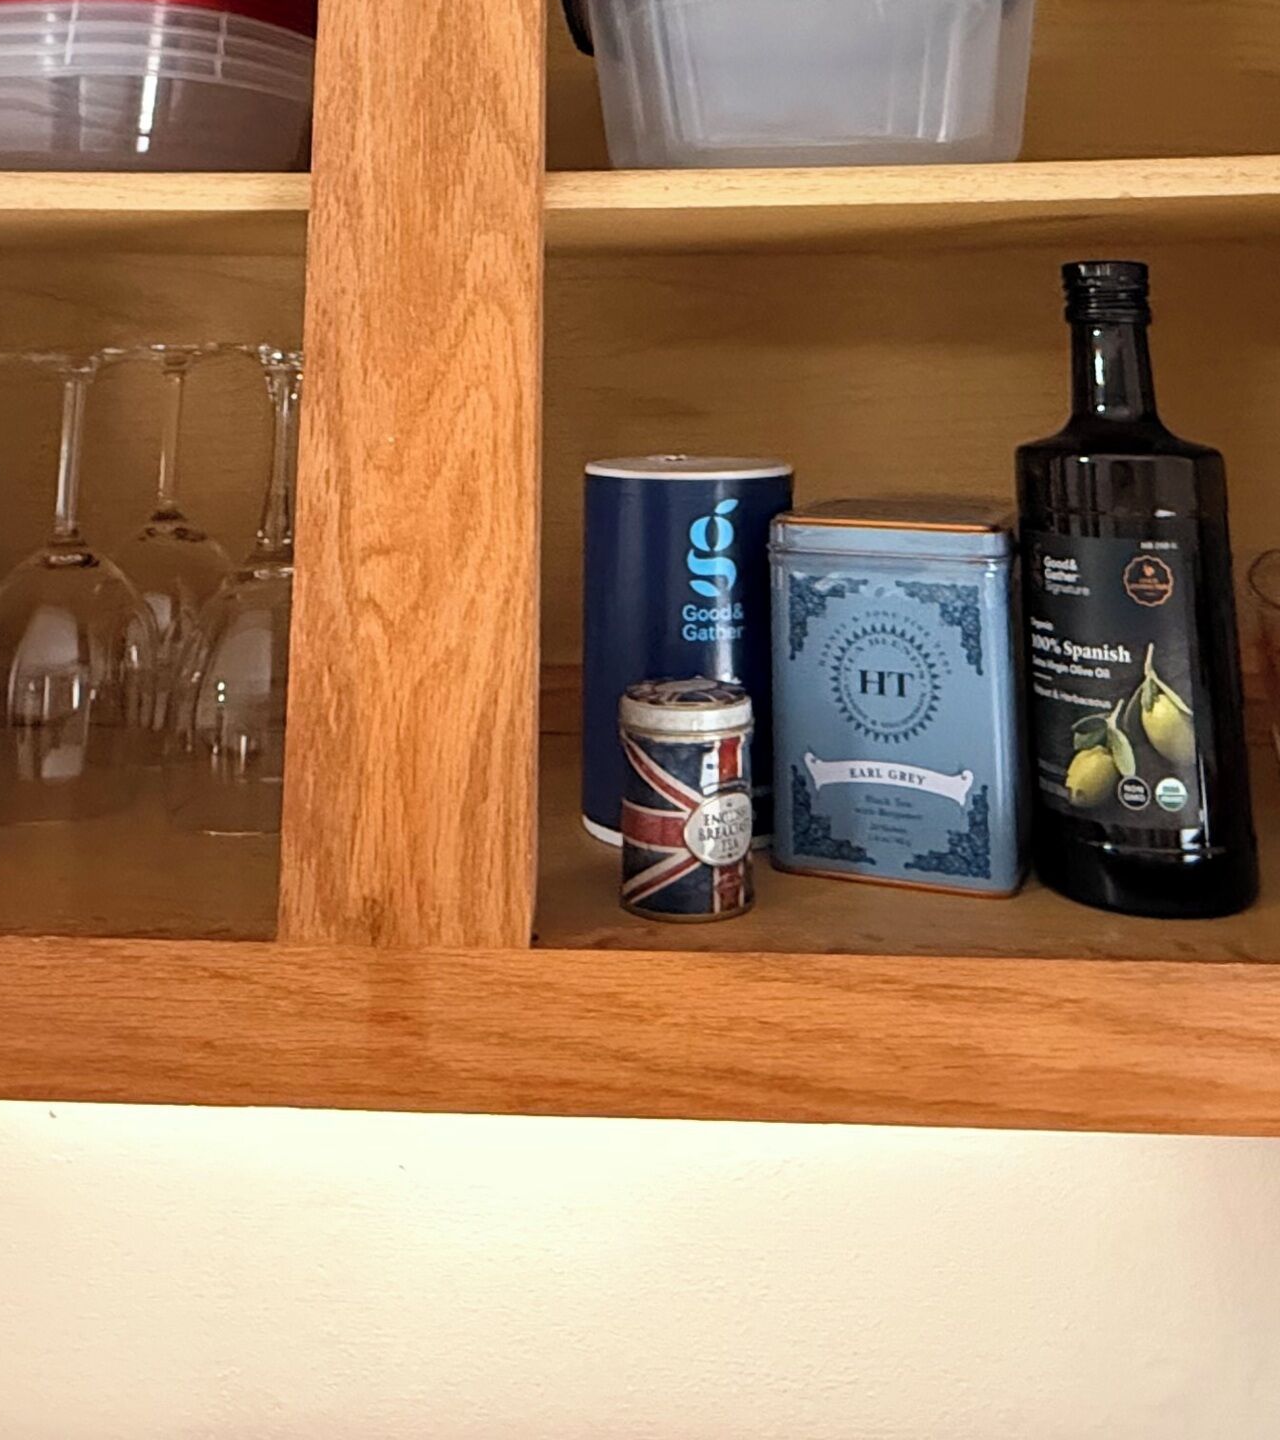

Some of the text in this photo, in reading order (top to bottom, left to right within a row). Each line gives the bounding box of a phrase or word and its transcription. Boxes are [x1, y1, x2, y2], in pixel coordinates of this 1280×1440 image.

[682, 623, 744, 641] Gather
[1063, 640, 1132, 663] Spanish
[859, 669, 915, 698] HT
[849, 767, 926, 786] EARL GREY
